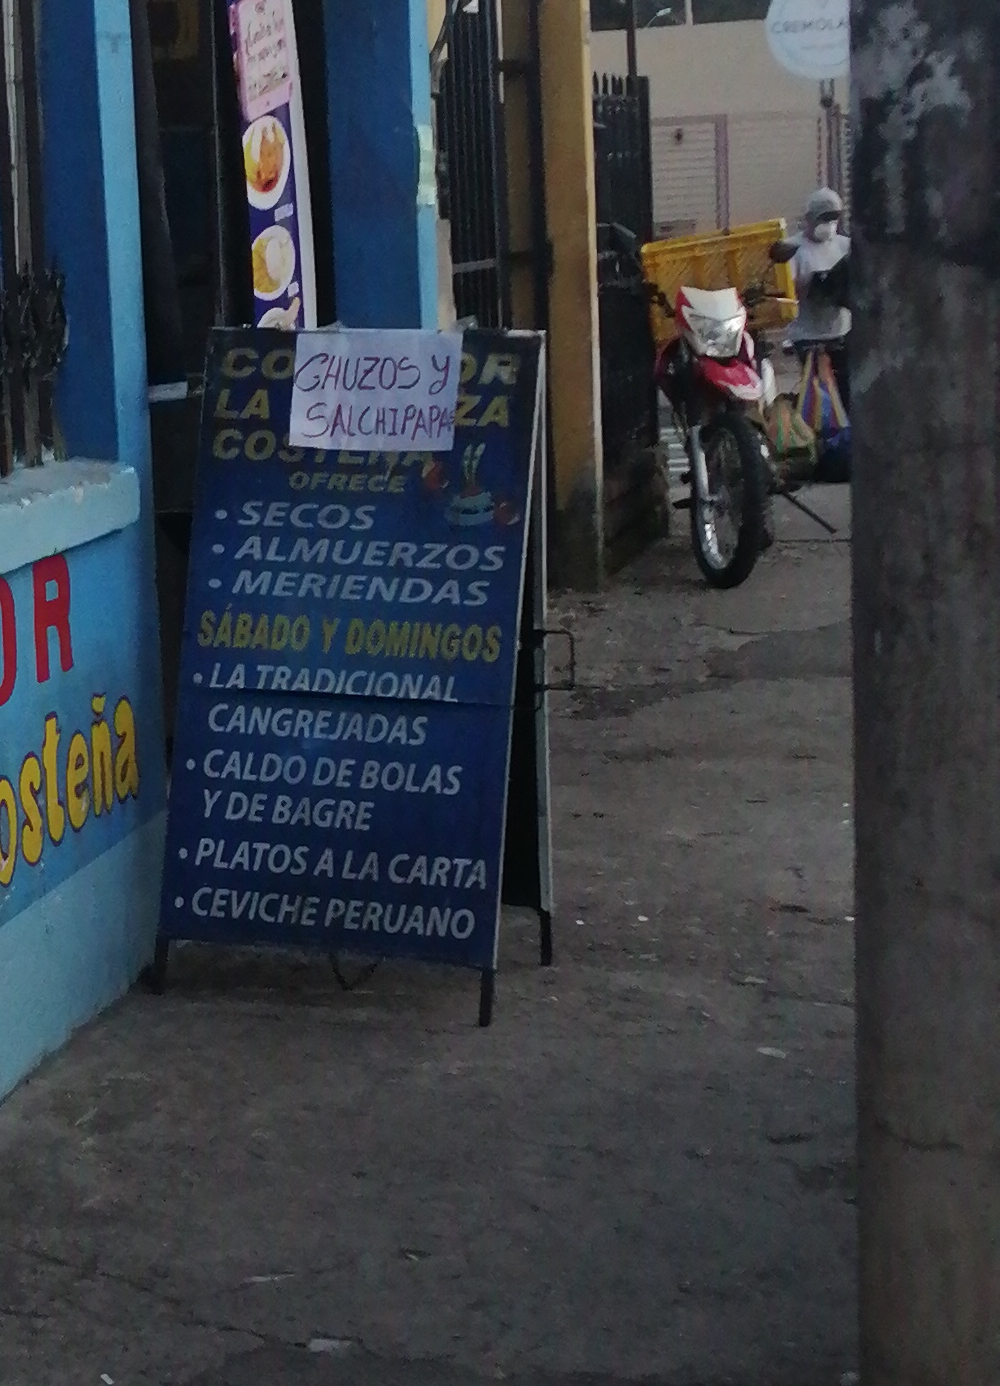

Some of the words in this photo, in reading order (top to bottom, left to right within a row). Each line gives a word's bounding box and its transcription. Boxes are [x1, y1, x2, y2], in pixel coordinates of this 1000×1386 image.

[214, 388, 270, 420] LA
[289, 470, 407, 493] OFRECE
[237, 500, 376, 531] SECOS
[233, 535, 506, 572] ALMUERZOS
[231, 570, 491, 606] MERIENDAS
[197, 603, 311, 651] SÁBADO
[322, 618, 342, 652] Y
[345, 618, 502, 663] DOMINGOS
[208, 662, 247, 690] LA
[255, 664, 460, 703] TRADICIONAL
[207, 702, 429, 746] CANGREJADAS
[203, 749, 308, 785] CALDO
[312, 757, 357, 789] DE
[359, 759, 463, 796] BOLAS
[202, 789, 222, 819] Y
[225, 791, 268, 822] DE
[271, 795, 375, 831] BAGRE
[195, 838, 309, 876] PLATOS
[313, 848, 335, 878] A
[341, 849, 380, 882] LA
[387, 854, 488, 890] CARTA
[191, 886, 320, 927] CEVICHE
[324, 898, 476, 940] PERUANO
